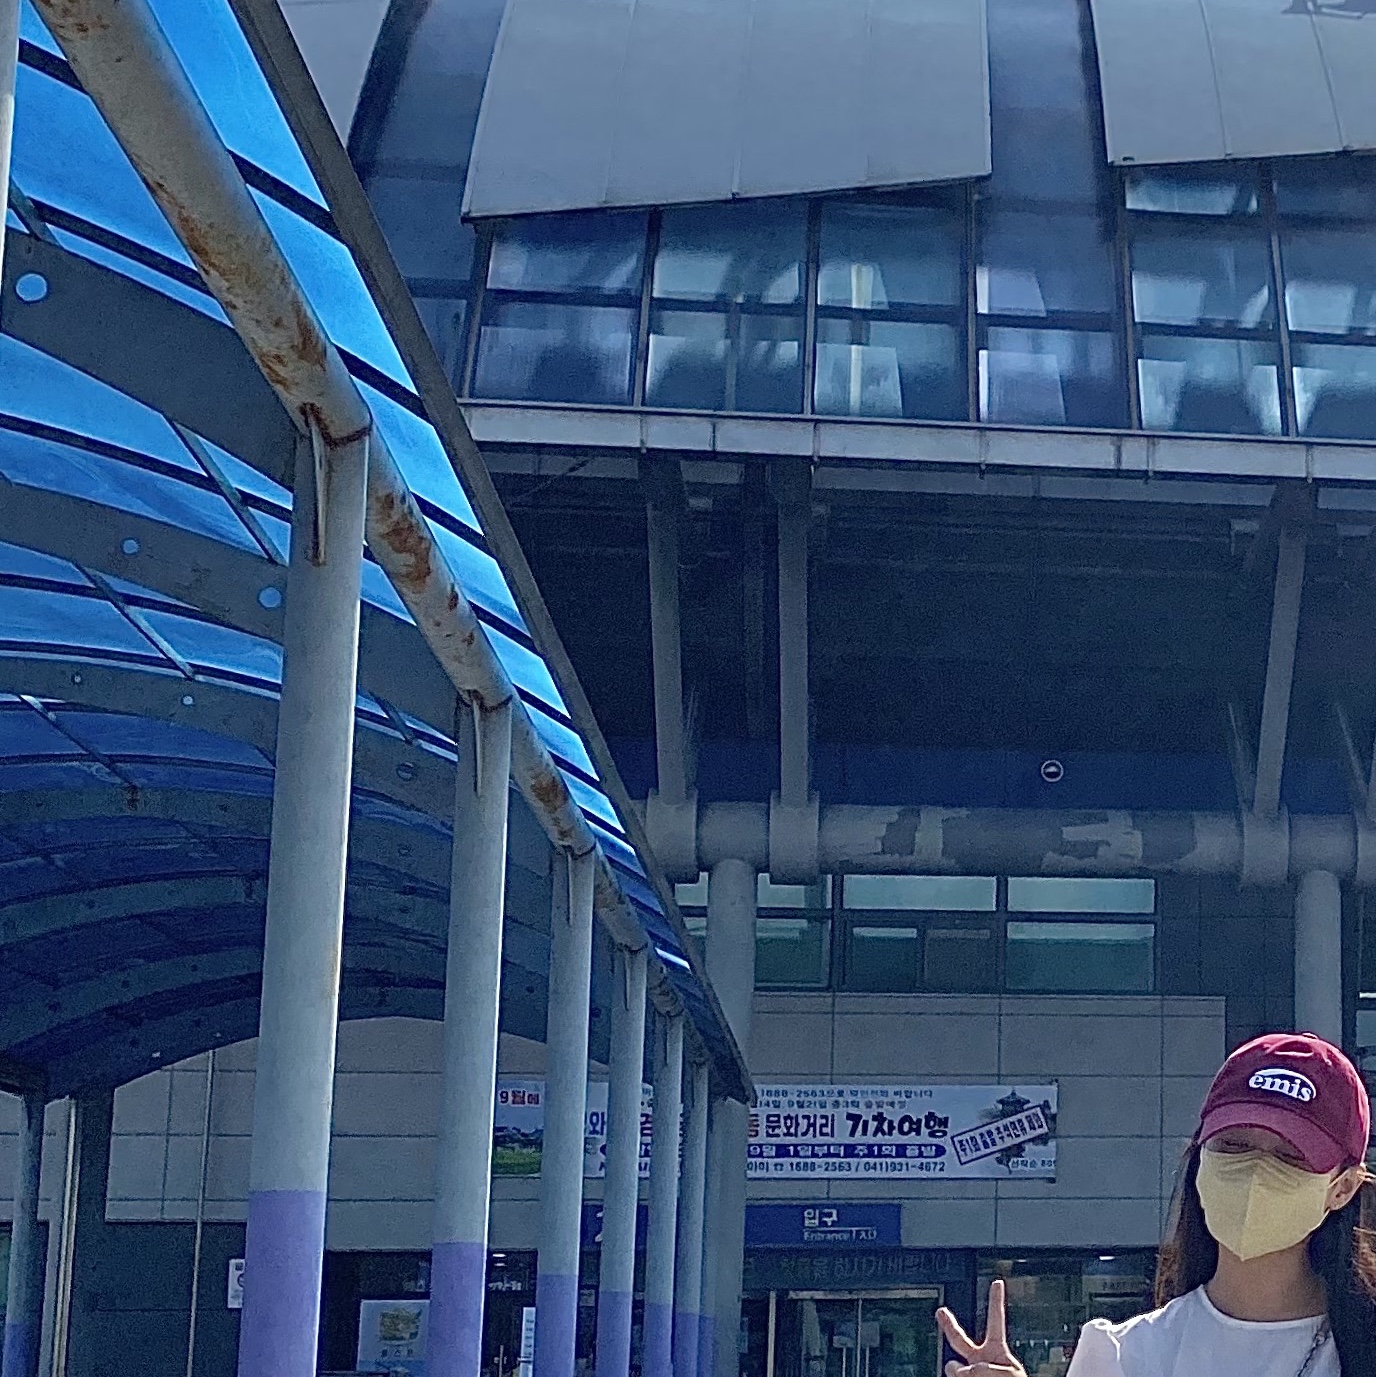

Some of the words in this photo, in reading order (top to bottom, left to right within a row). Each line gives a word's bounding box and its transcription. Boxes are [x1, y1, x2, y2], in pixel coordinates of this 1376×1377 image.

[1248, 1074, 1312, 1102] emis
[765, 1113, 835, 1138] 문화거리
[845, 1111, 950, 1138] 기차여행
[803, 1208, 839, 1228] 입구
